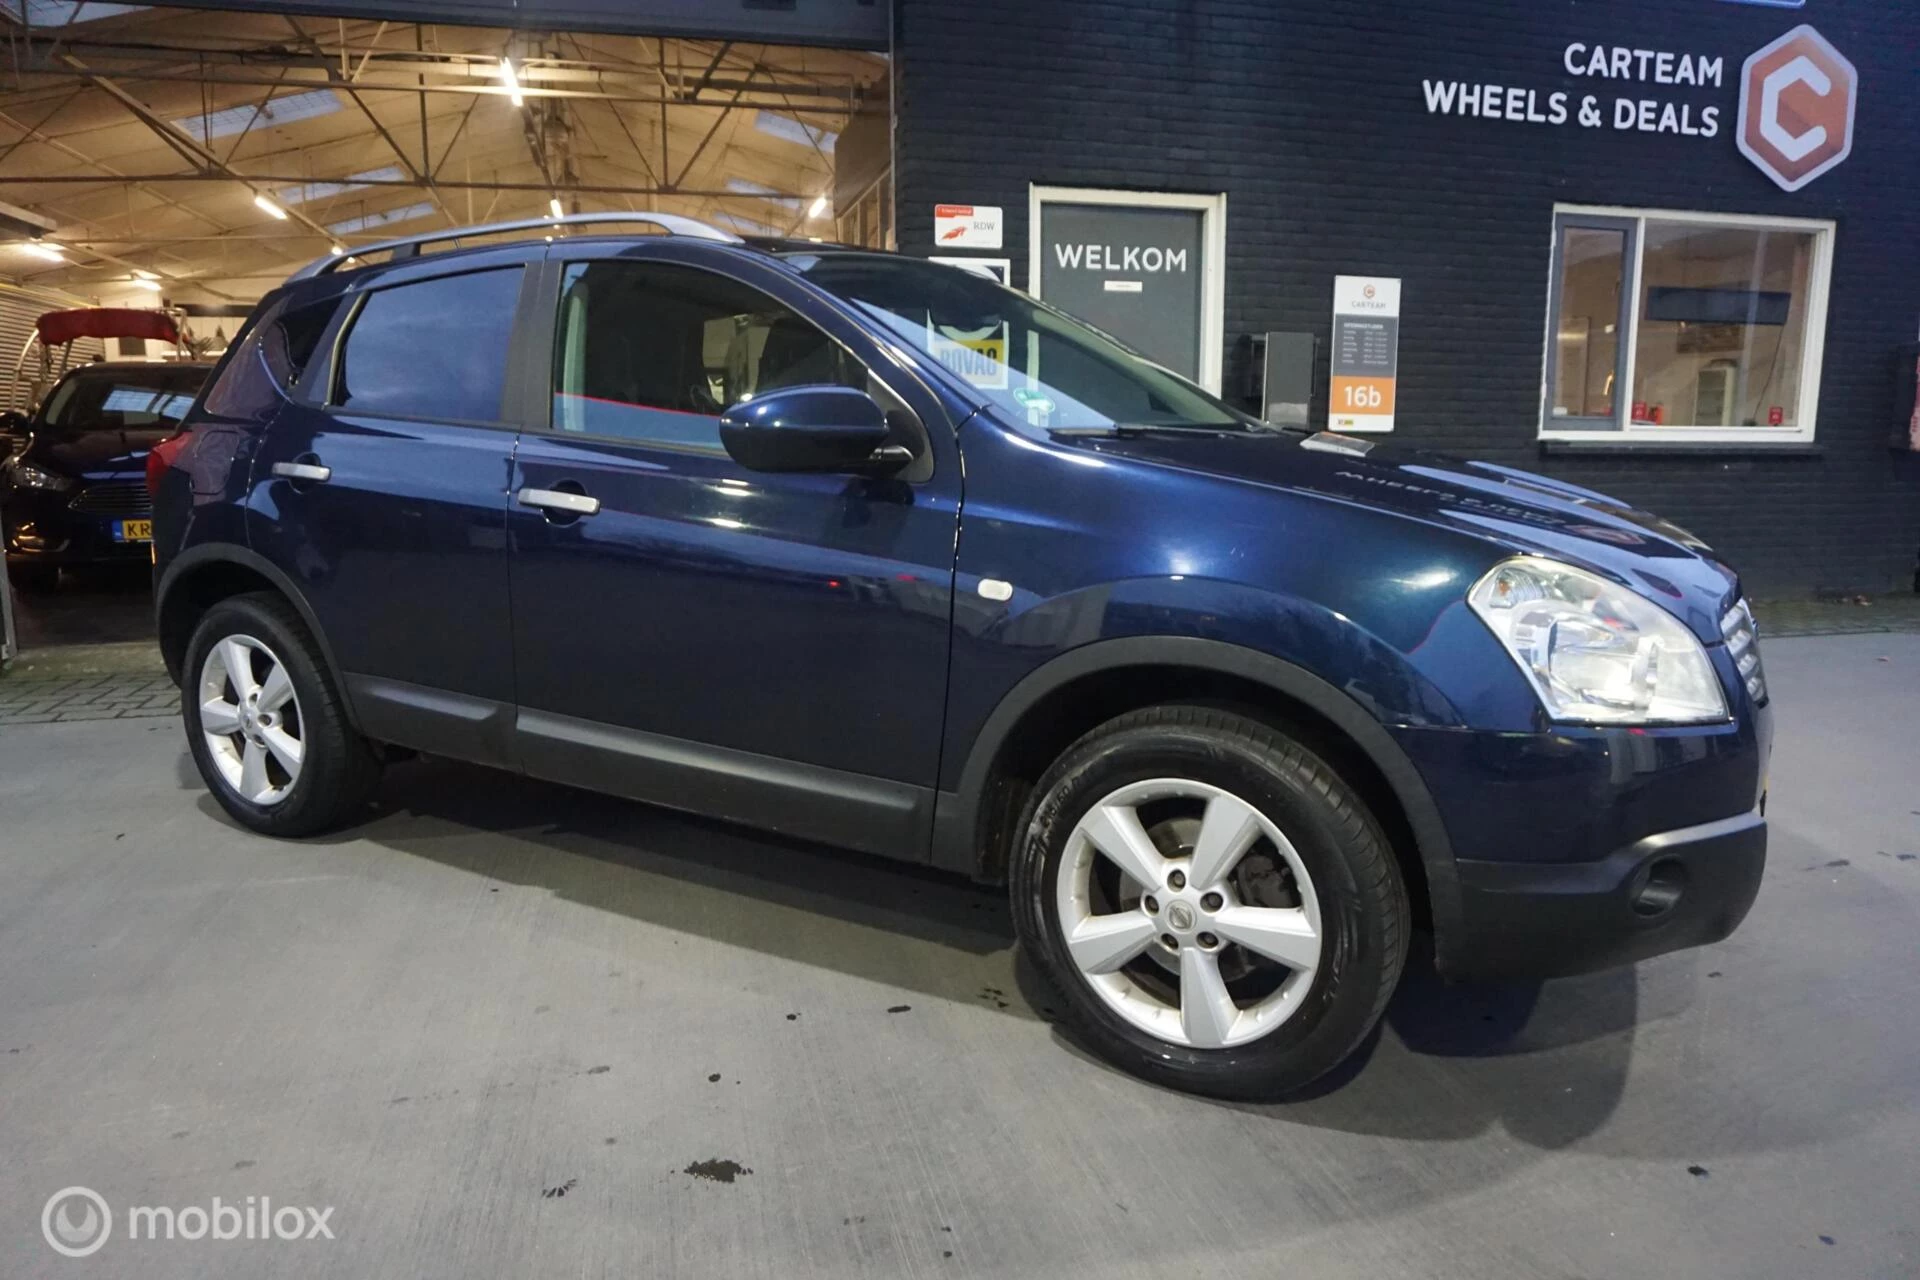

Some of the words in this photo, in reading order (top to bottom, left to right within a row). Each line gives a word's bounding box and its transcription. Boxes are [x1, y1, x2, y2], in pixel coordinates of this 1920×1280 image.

[1564, 43, 1723, 88] CARTEAM
[1423, 80, 1568, 125] WHEELS
[1578, 96, 1602, 128] &
[1614, 99, 1720, 138] DEALS
[1055, 244, 1187, 273] WELKOM
[1343, 385, 1382, 407] 16b
